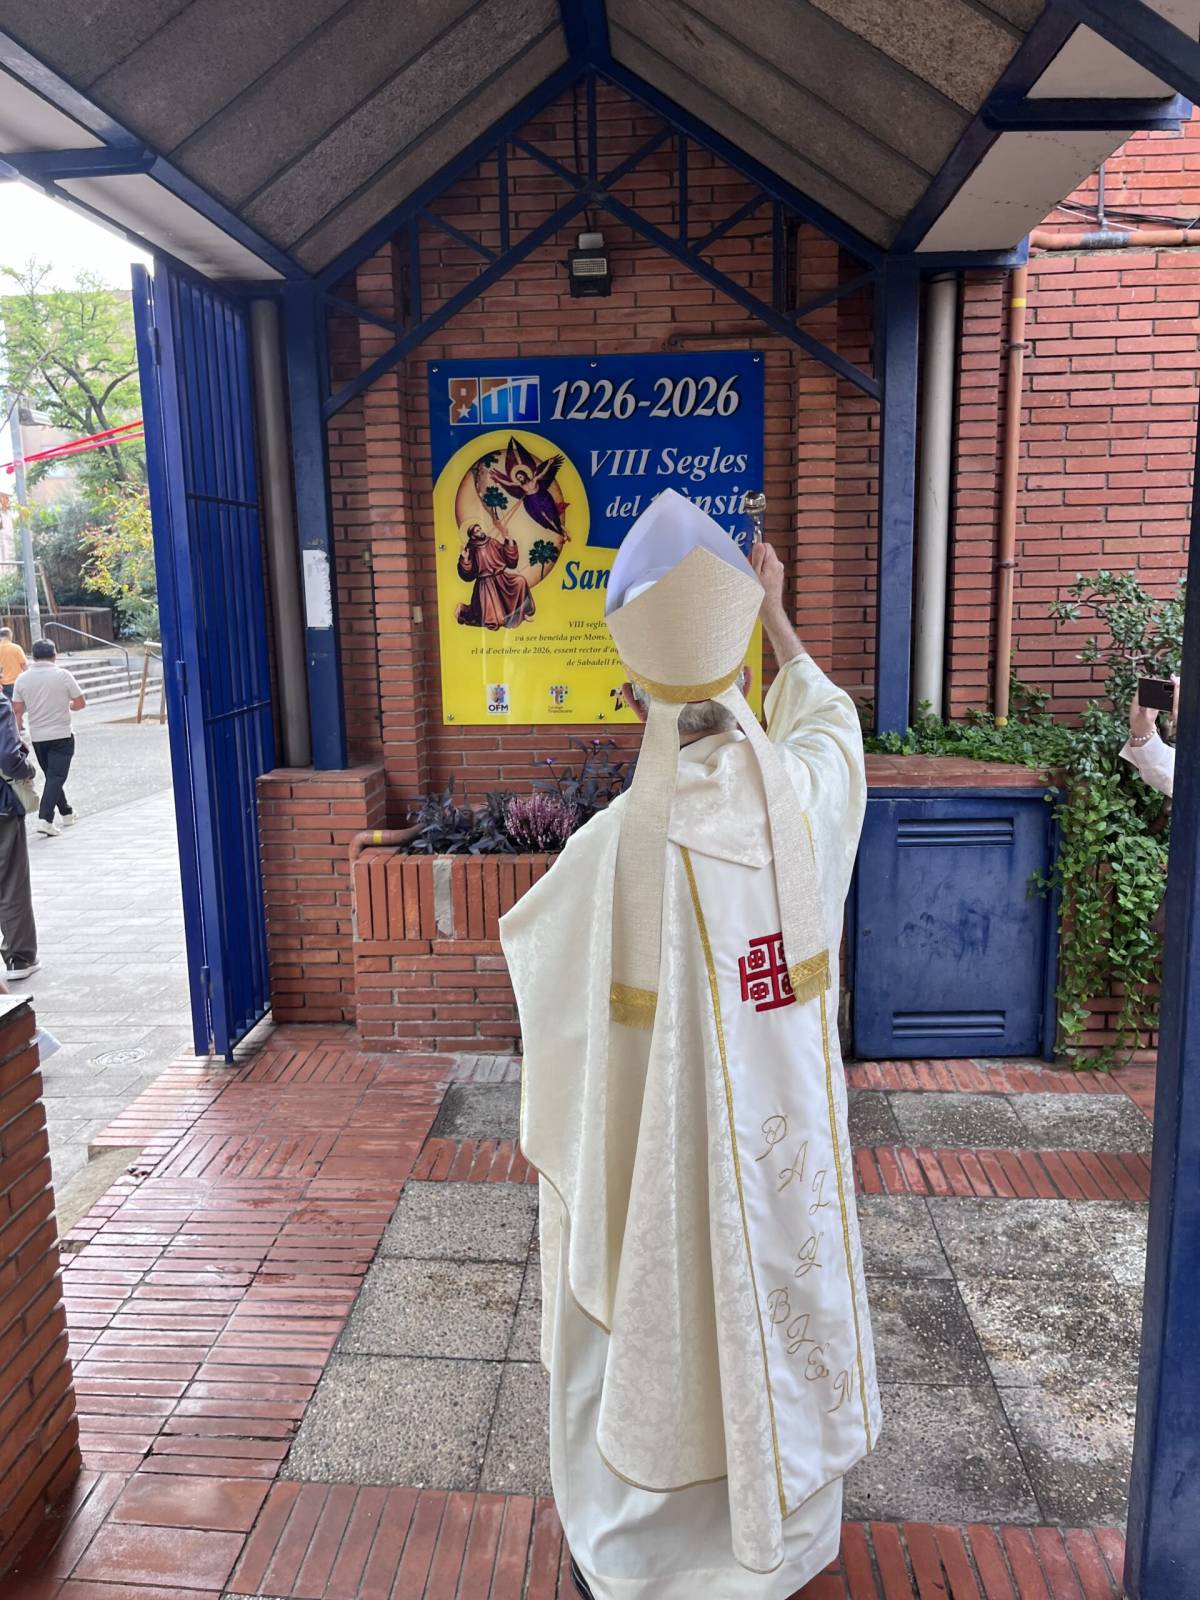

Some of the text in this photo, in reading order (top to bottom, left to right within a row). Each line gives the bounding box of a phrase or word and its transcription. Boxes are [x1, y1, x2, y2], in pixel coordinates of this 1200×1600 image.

[550, 374, 740, 421] 1226-2026
[589, 446, 749, 482] VIII Segles
[605, 495, 641, 518] del
[561, 560, 611, 591] San
[488, 704, 509, 712] OFM
